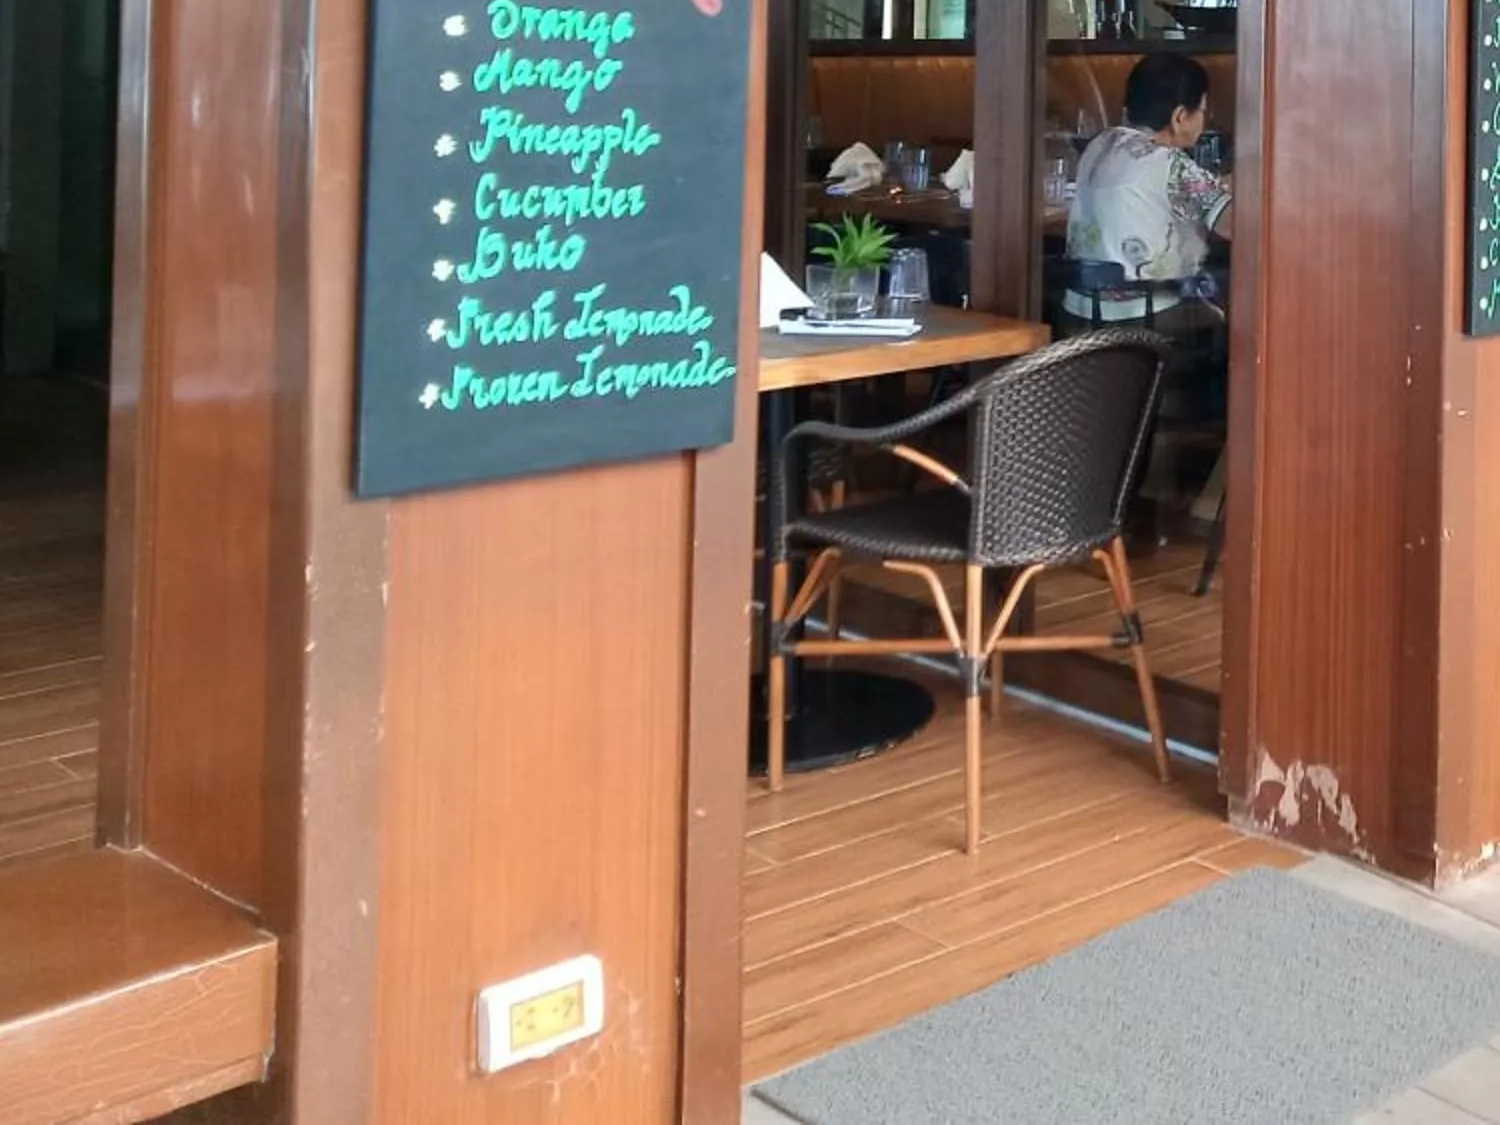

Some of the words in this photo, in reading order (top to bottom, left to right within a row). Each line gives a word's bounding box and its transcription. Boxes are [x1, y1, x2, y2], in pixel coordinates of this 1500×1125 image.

[473, 49, 623, 113] Mango
[469, 106, 661, 172] Pineapple
[474, 169, 646, 225] Cucumber
[457, 225, 587, 284] Buko
[445, 291, 560, 348] Fresh
[564, 283, 712, 345] Lemonade
[570, 340, 737, 398] Lemonade
